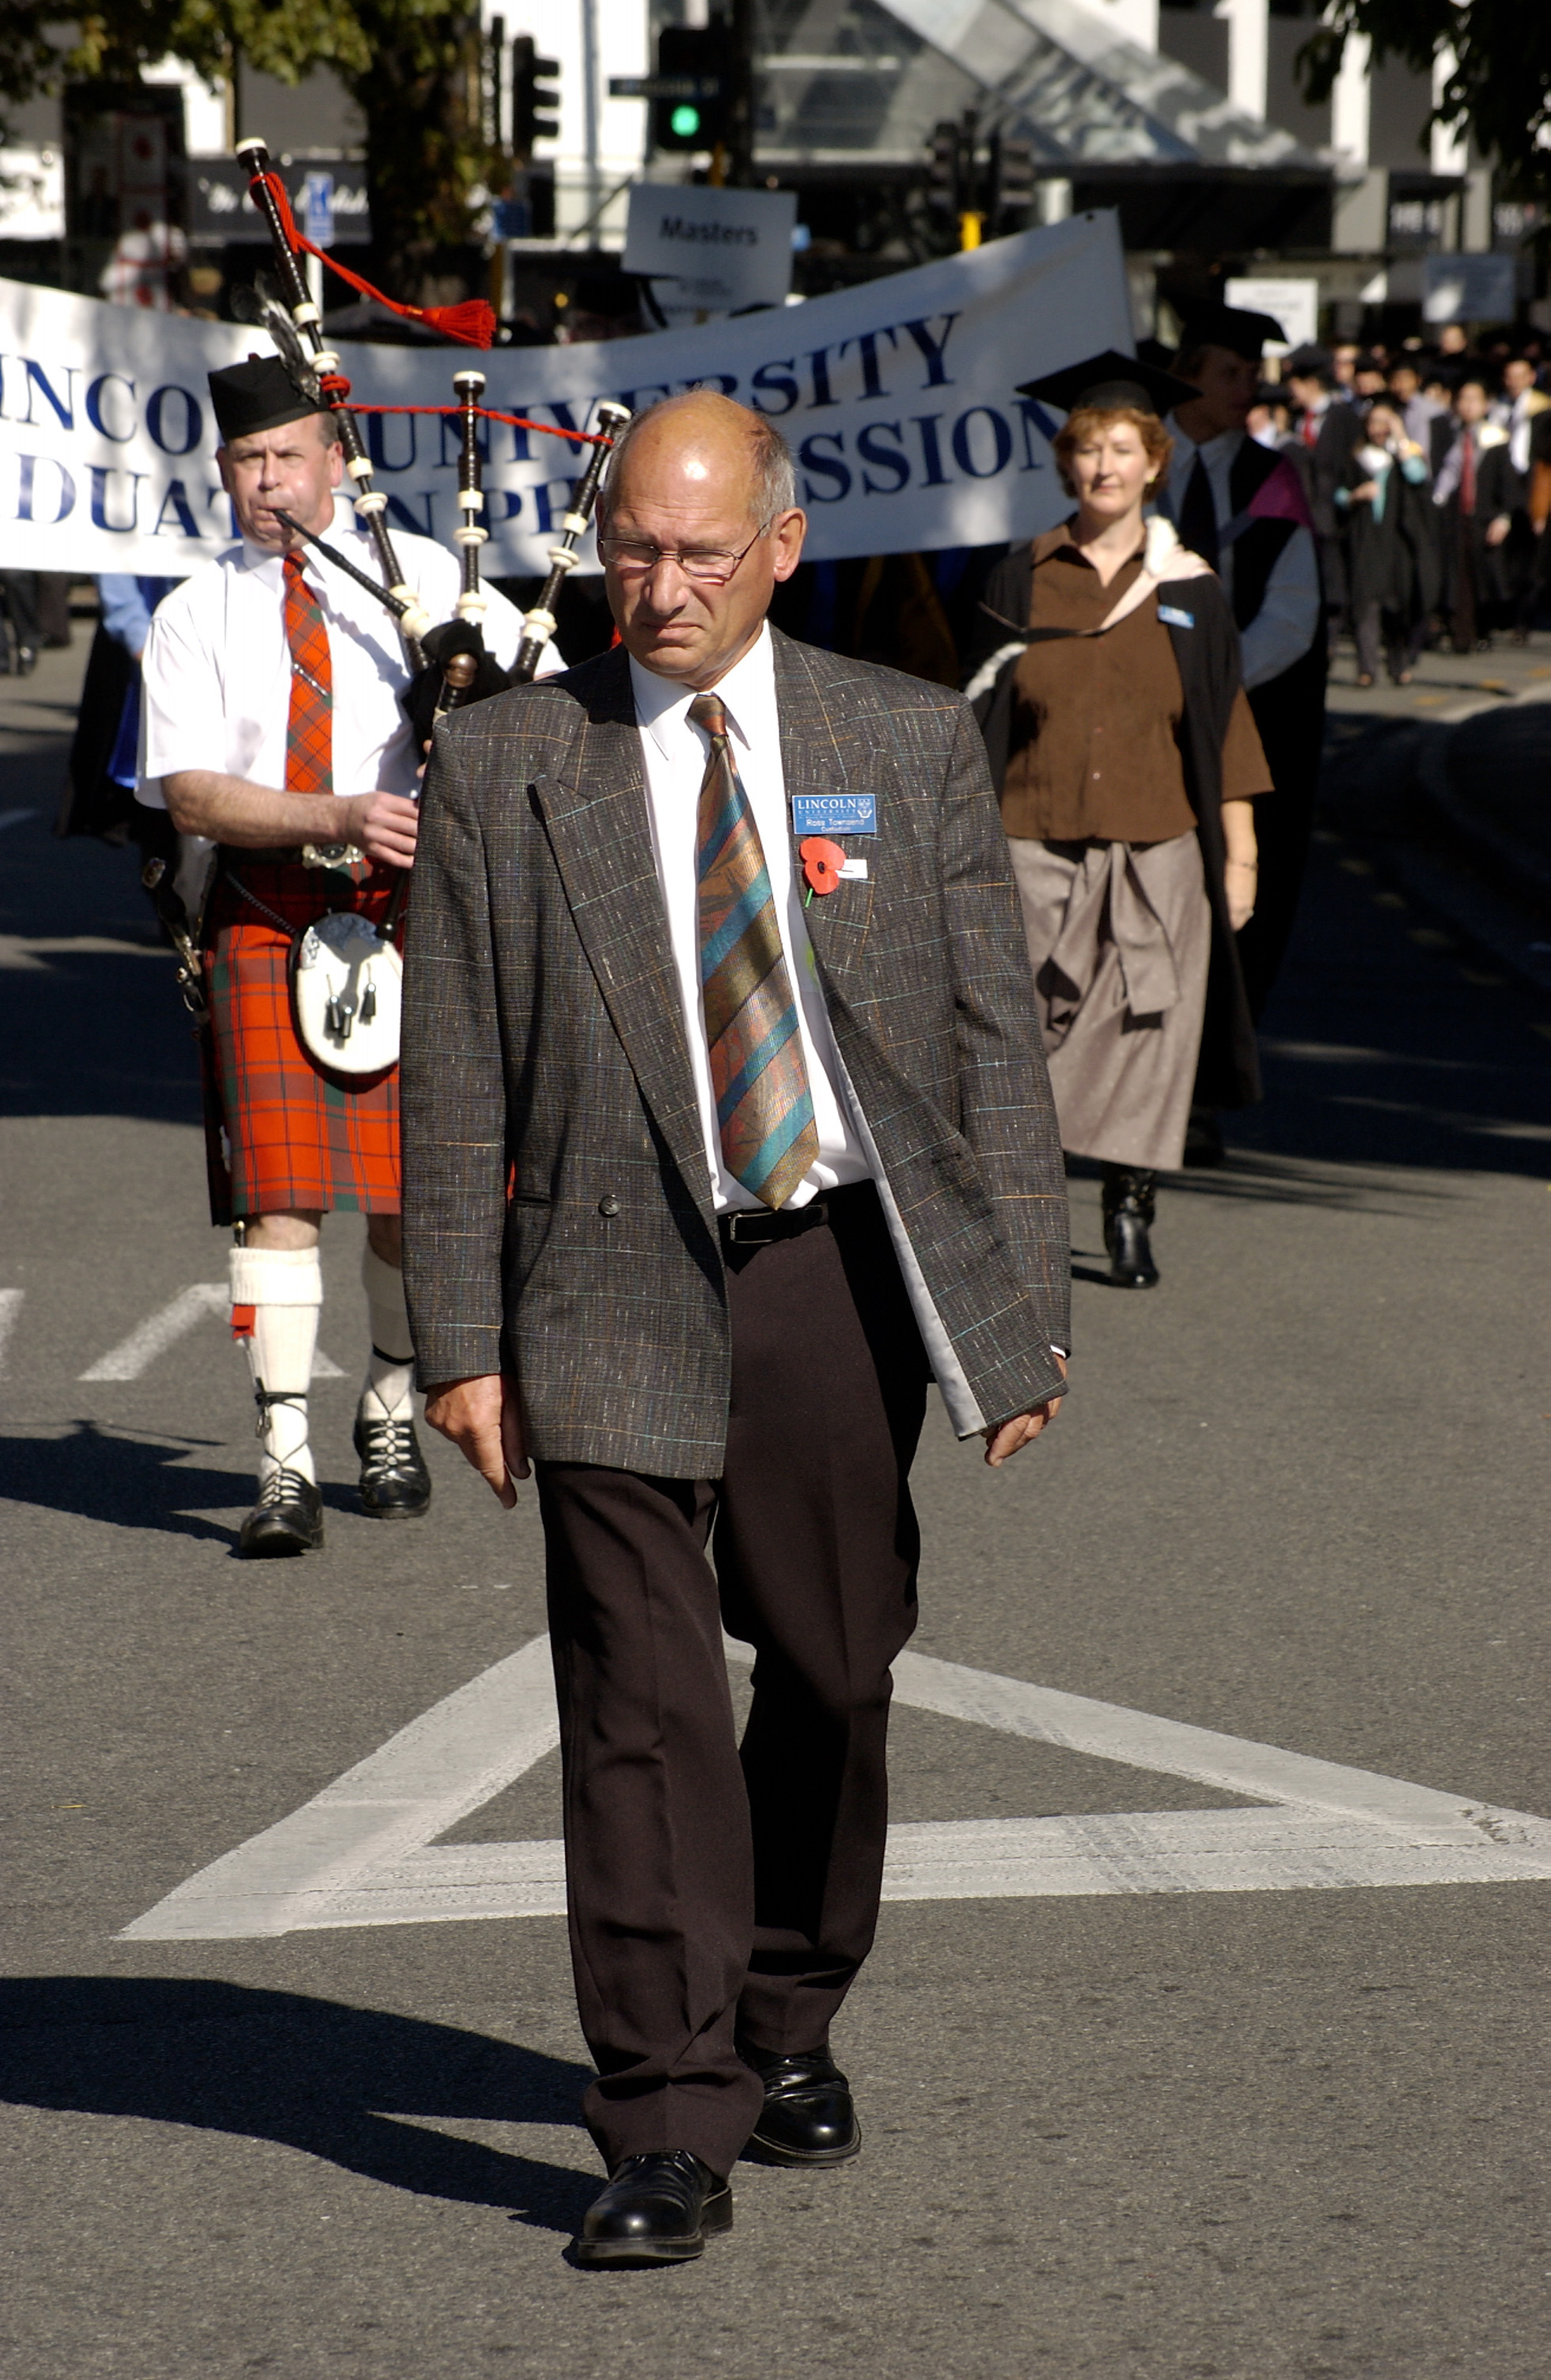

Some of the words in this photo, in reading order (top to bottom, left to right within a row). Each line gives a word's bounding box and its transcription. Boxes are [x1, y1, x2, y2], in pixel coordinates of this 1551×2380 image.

[658, 216, 758, 247] Masters
[358, 312, 962, 473] UNIVSITY
[472, 396, 1063, 544] PRSSION
[798, 798, 856, 809] LINCOLN
